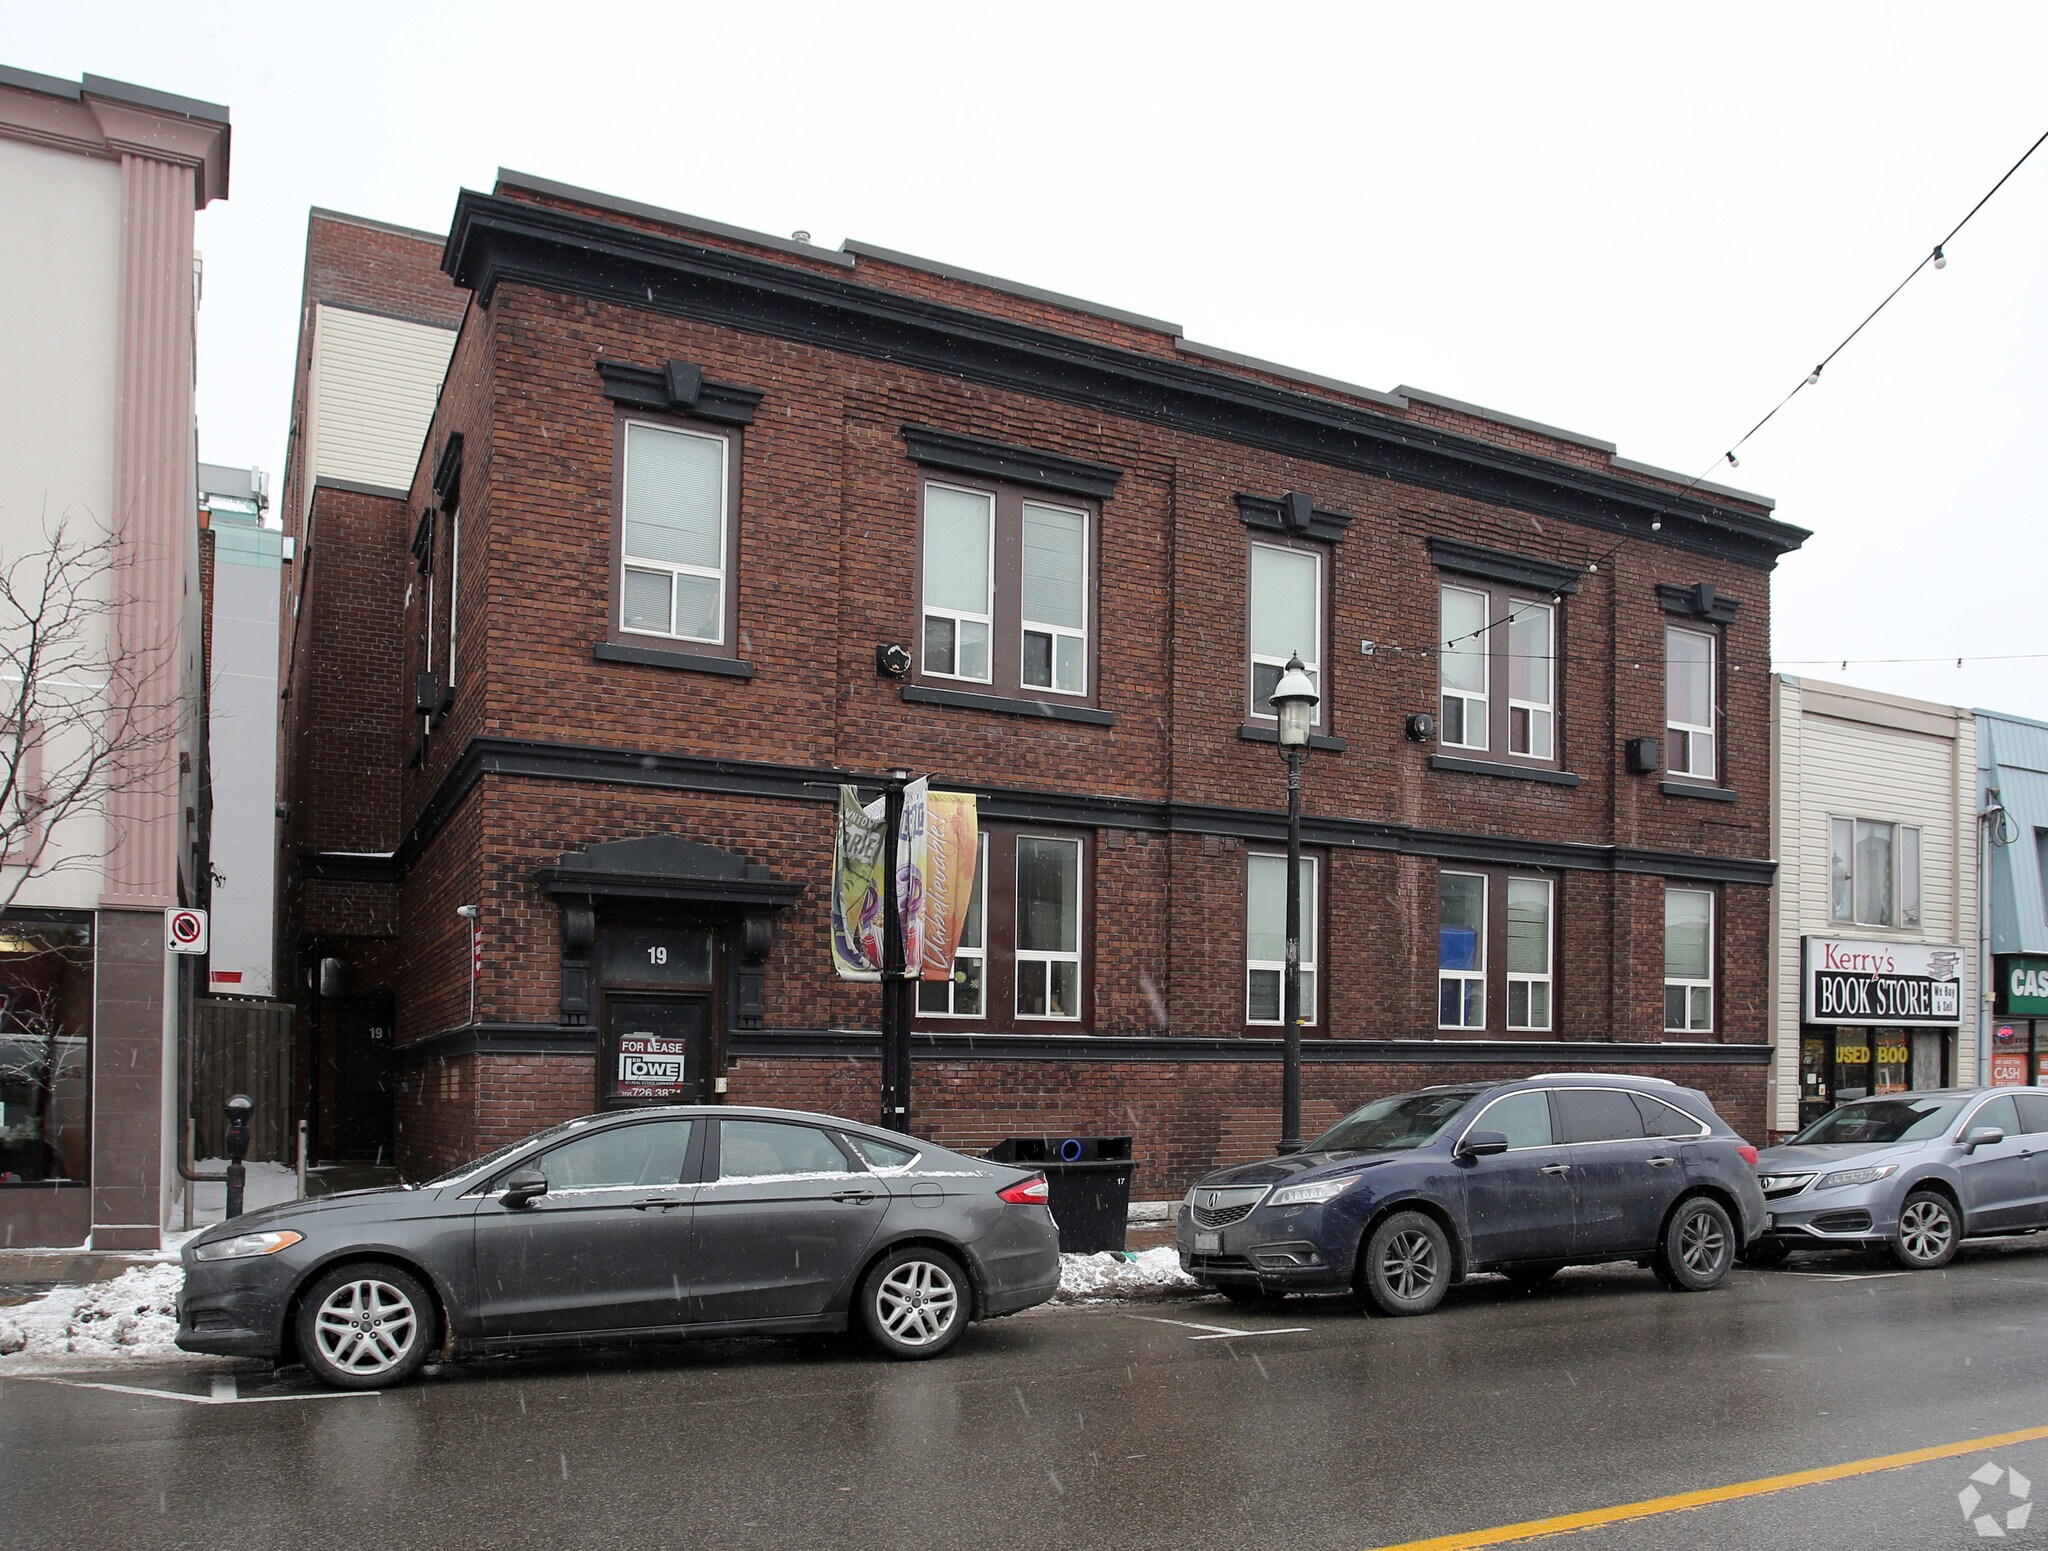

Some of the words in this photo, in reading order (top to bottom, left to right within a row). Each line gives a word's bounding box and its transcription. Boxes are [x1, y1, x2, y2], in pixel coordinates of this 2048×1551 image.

[922, 809, 949, 970] Unbelievable!
[647, 946, 668, 965] 19
[1824, 943, 1895, 980] Kerry's
[1821, 976, 1871, 1014] BOOK
[1876, 979, 1930, 1016] STORE
[1934, 986, 1942, 996] We
[1945, 986, 1955, 998] Buy
[369, 1027, 383, 1039] 19
[622, 1041, 644, 1052] FOR
[647, 1042, 683, 1053] LEASE
[1836, 1046, 1871, 1064] USED
[625, 1058, 679, 1080] LOWE
[1994, 1067, 2020, 1079] CASH
[632, 1088, 653, 1097] 726
[1117, 1177, 1125, 1185] 17
